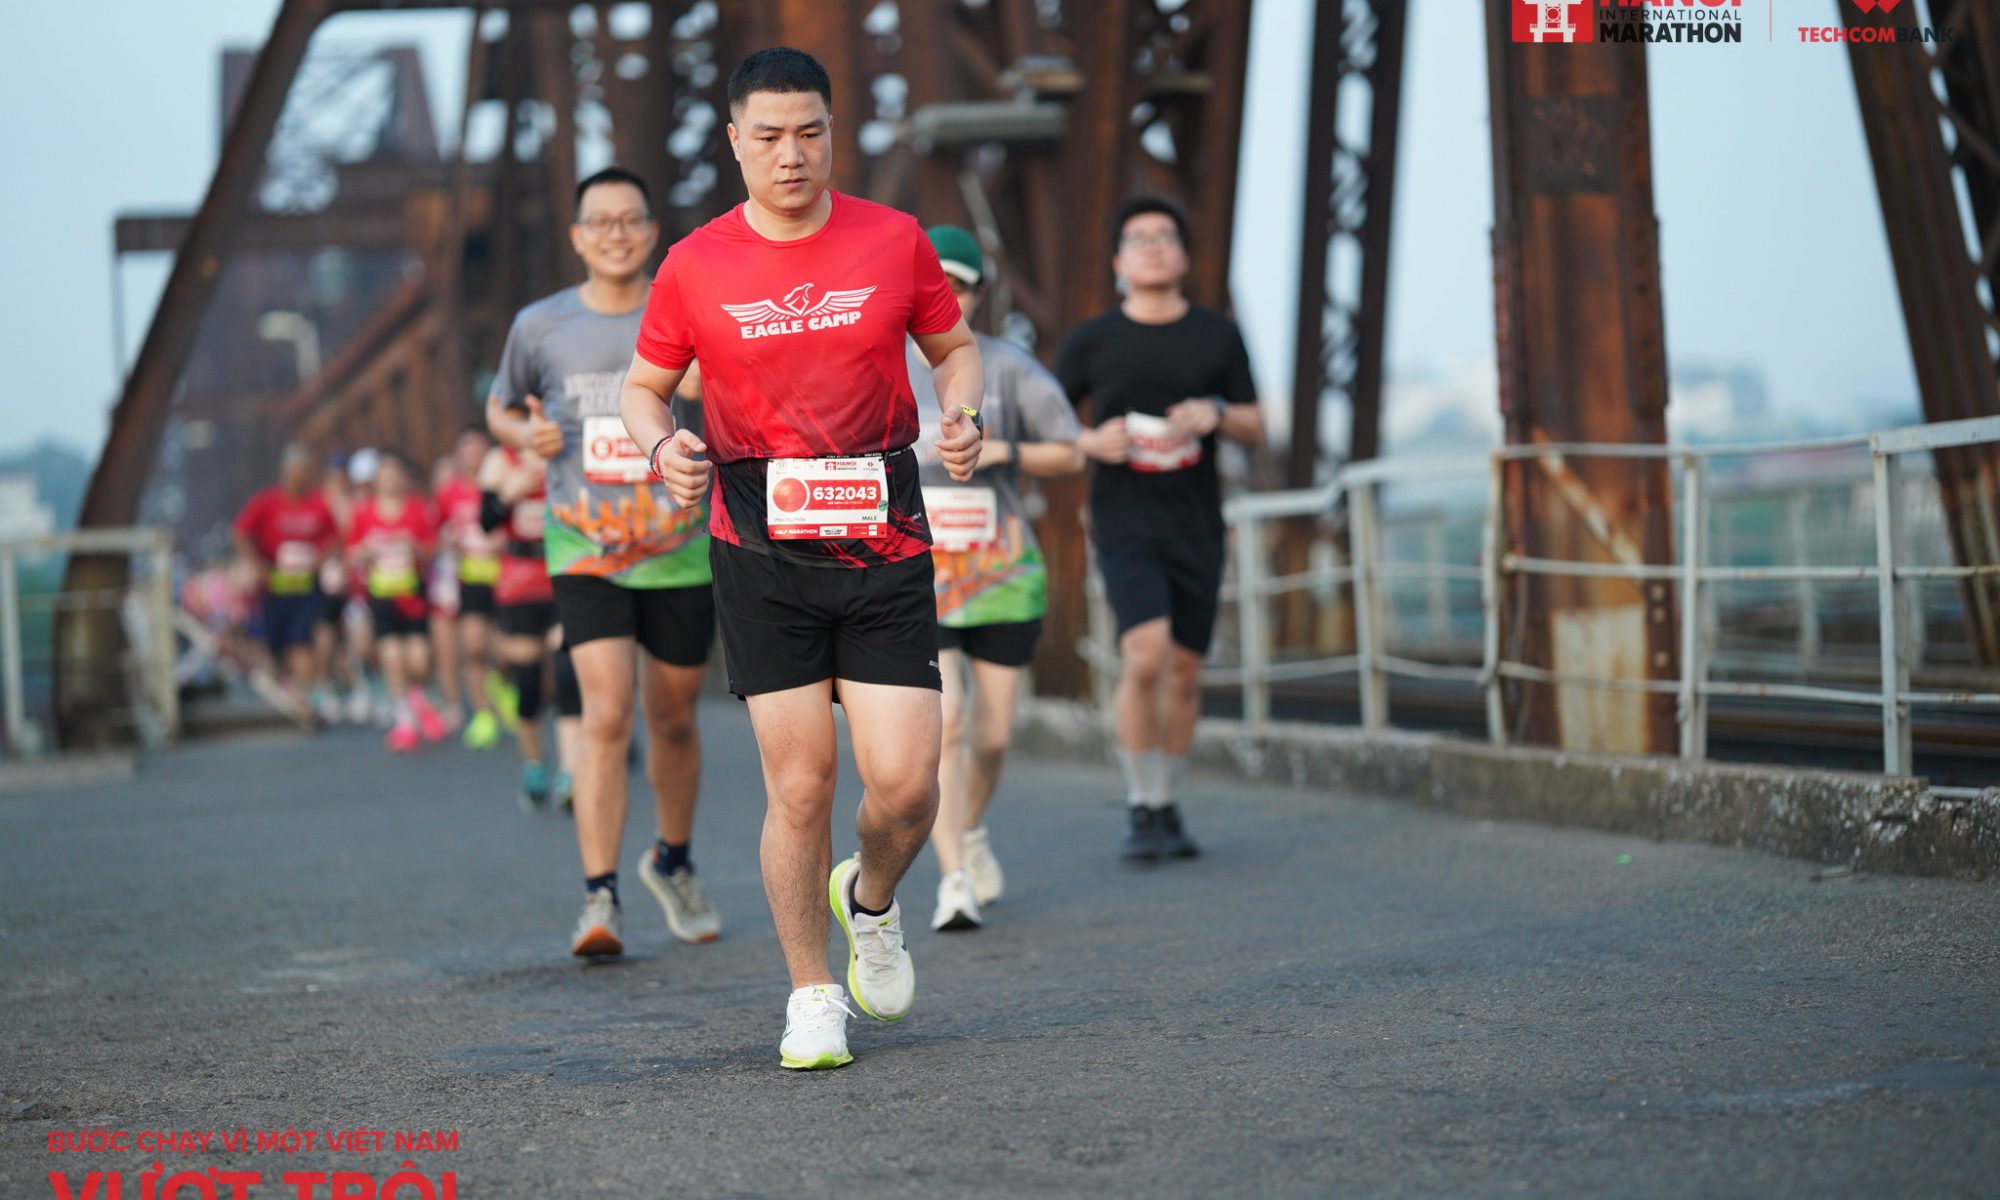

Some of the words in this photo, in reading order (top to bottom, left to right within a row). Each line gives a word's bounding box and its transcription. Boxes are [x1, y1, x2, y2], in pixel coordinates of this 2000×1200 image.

[740, 319, 804, 339] EAGLE
[807, 311, 862, 331] CAMP
[813, 486, 877, 501] 632043
